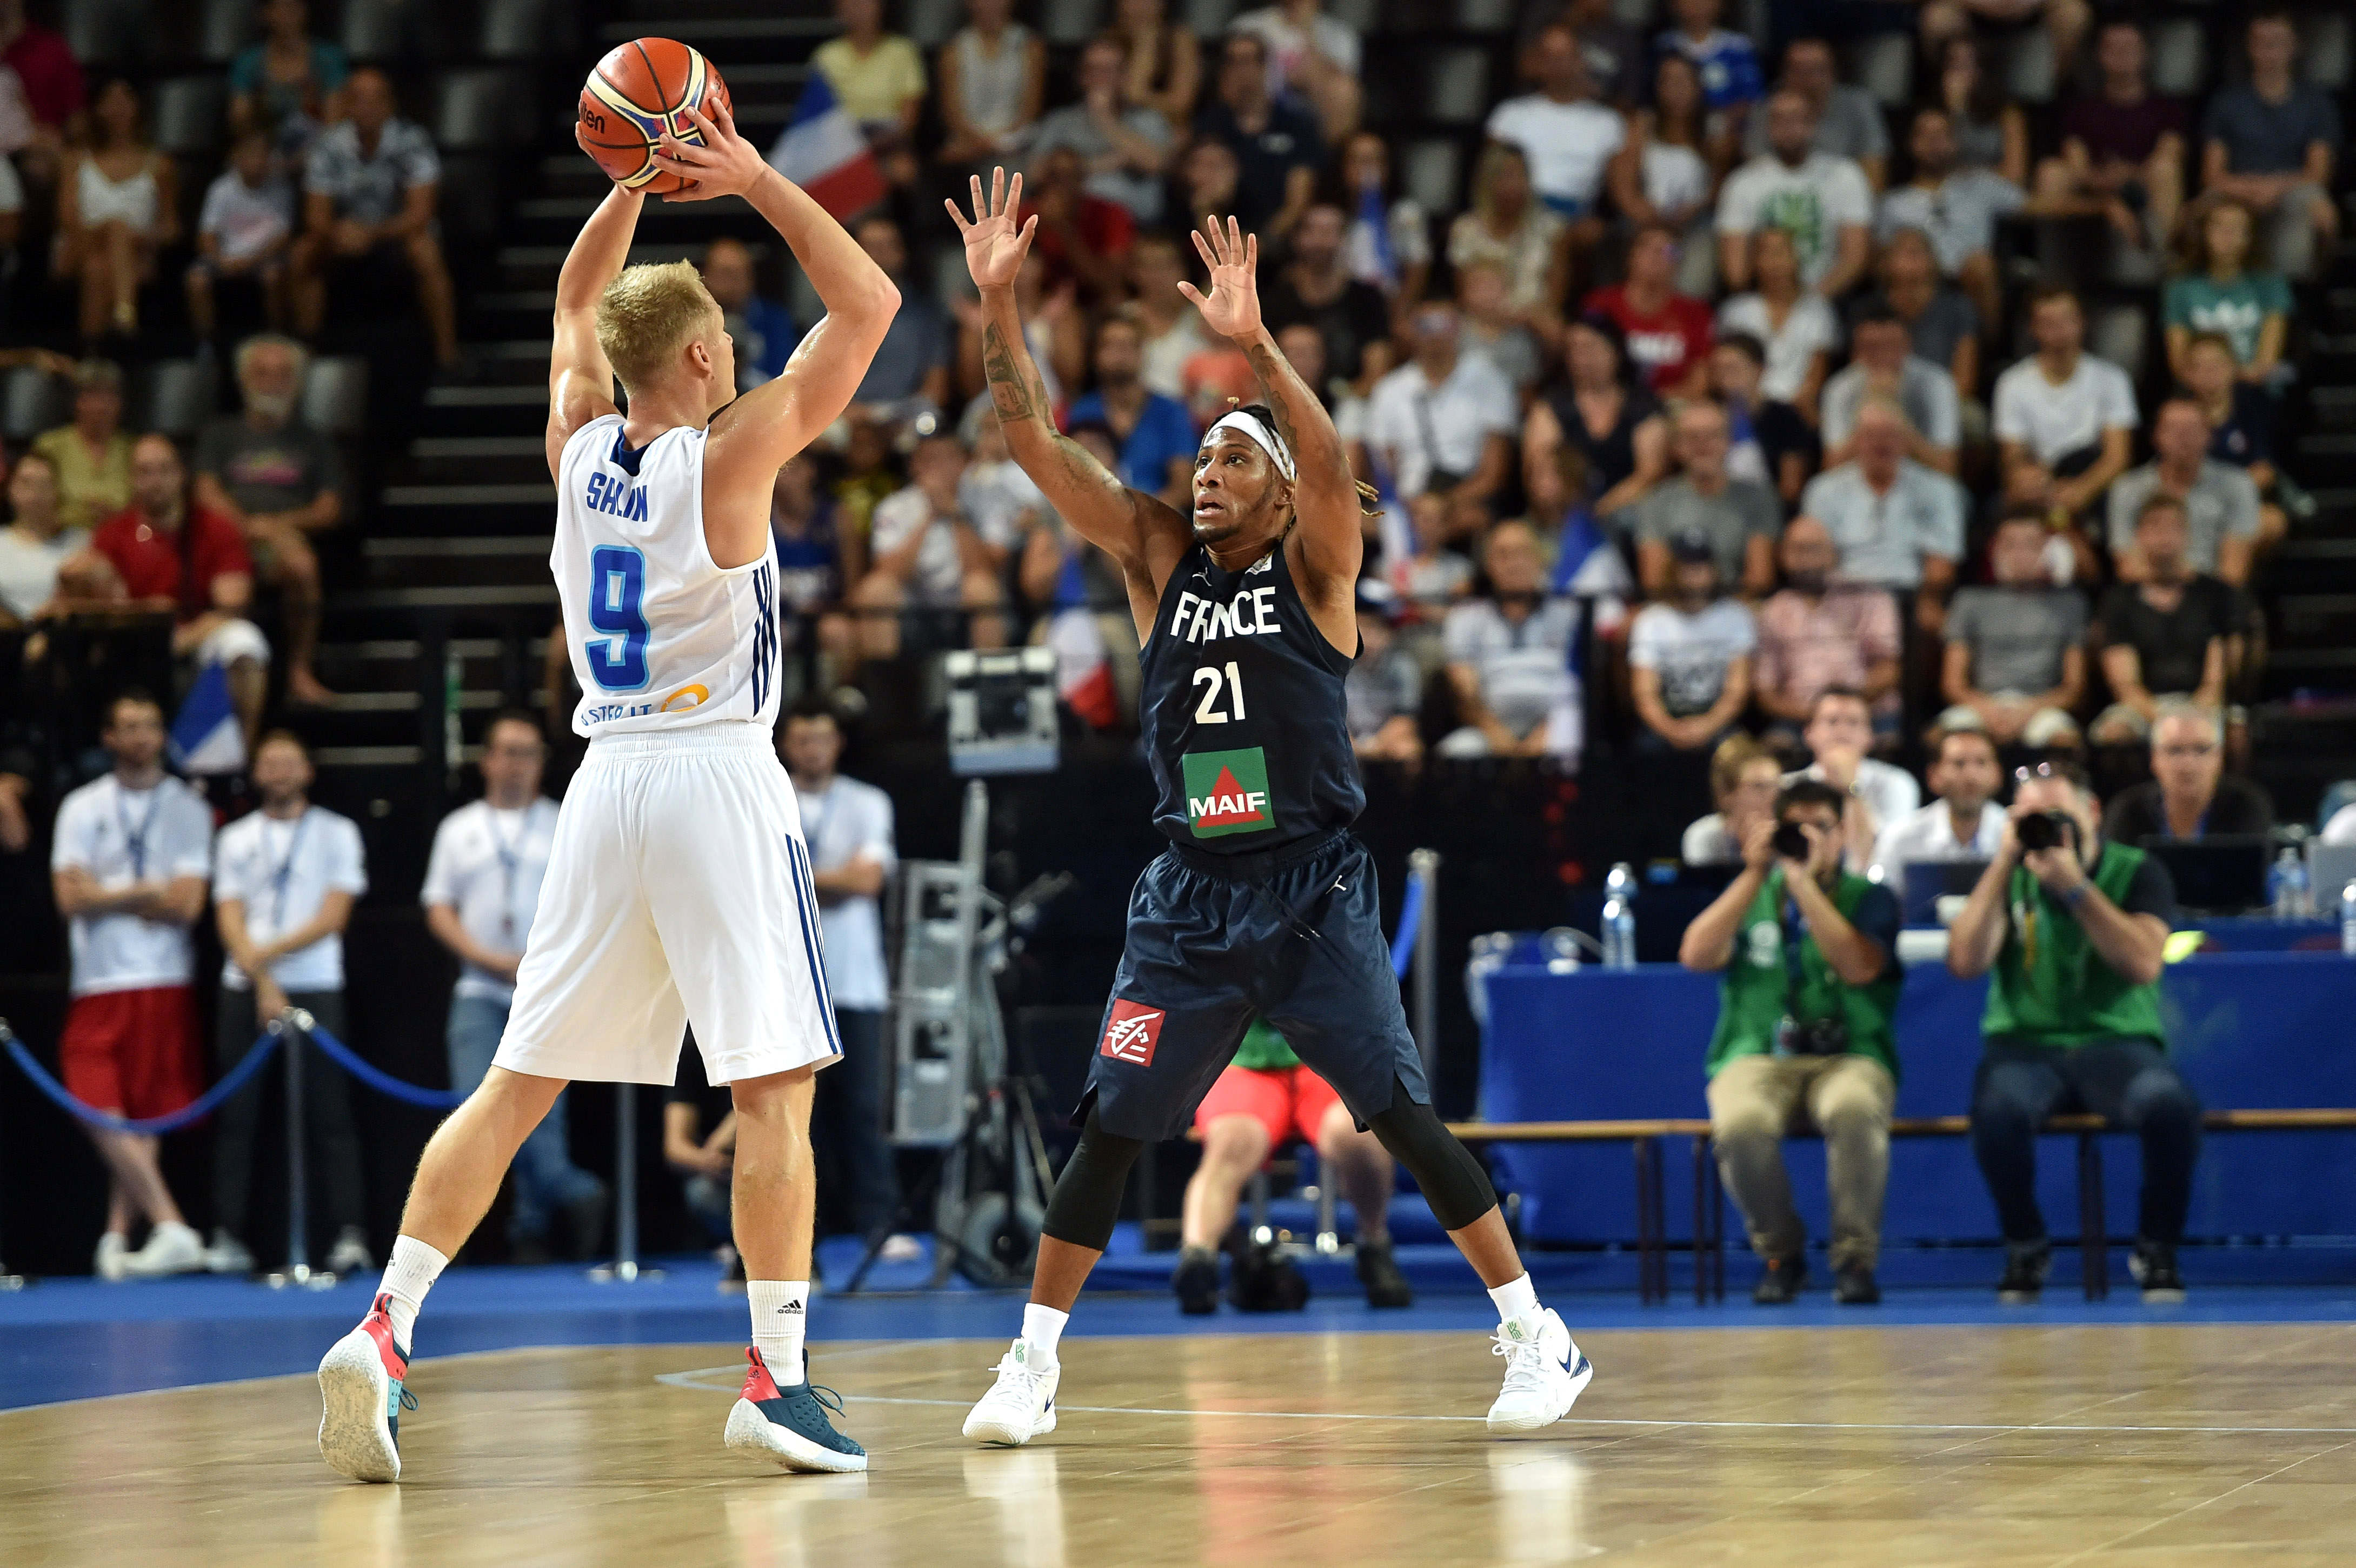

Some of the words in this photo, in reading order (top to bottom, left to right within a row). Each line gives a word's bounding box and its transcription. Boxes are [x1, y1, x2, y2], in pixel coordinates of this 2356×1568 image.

[586, 471, 648, 522] SALIN
[585, 544, 651, 691] 9
[1193, 661, 1246, 724] 21
[1189, 791, 1266, 818] MAIF
